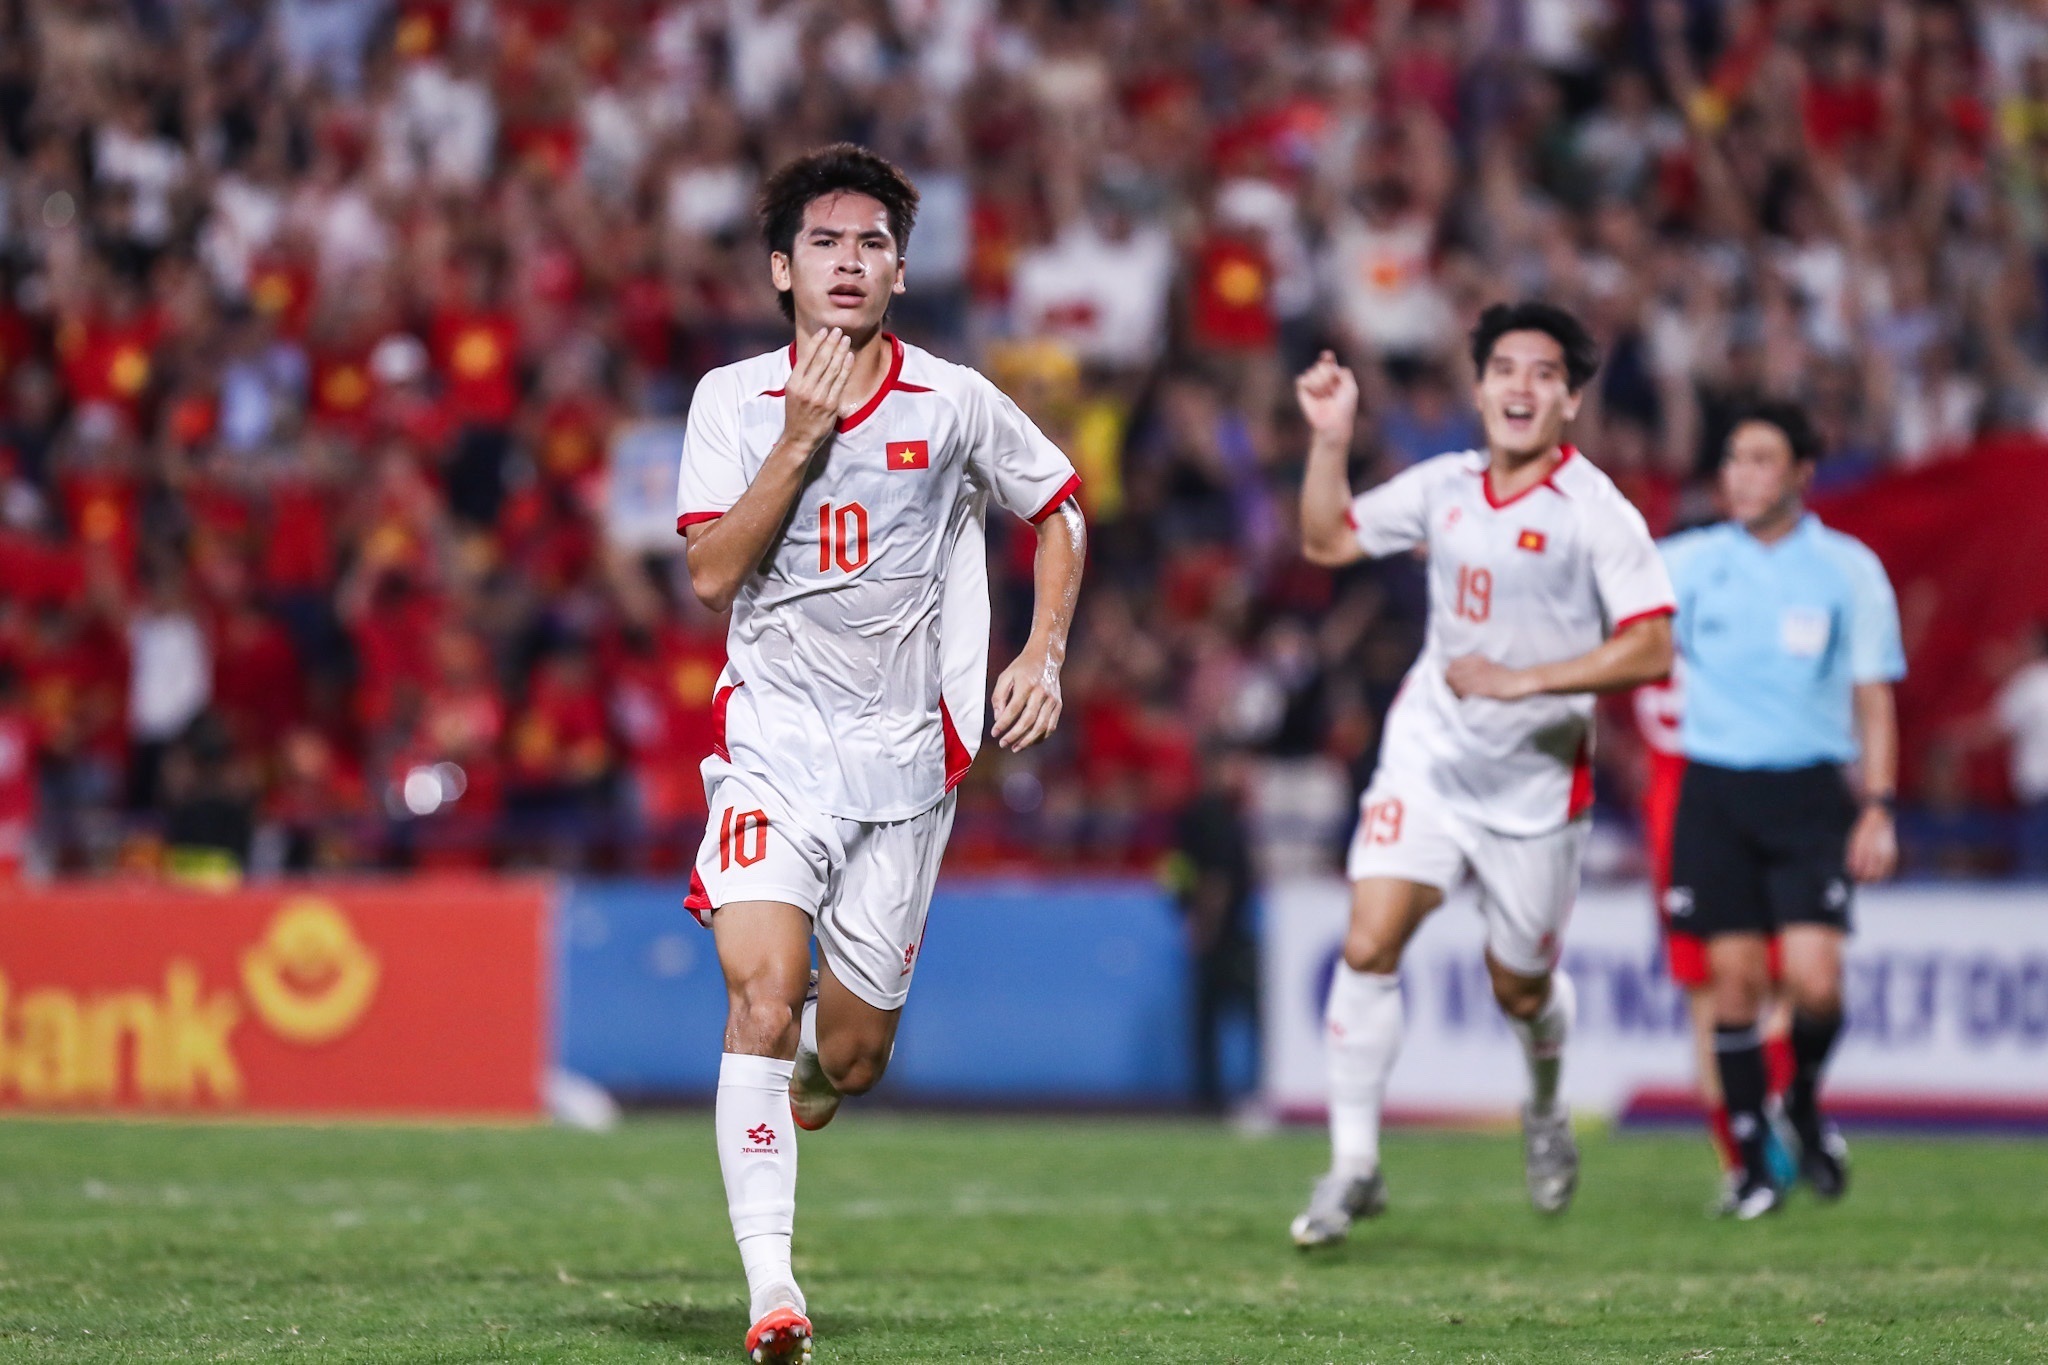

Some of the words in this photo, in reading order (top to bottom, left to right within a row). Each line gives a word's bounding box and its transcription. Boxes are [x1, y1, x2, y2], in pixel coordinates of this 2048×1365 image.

[818, 501, 869, 574] 10
[1456, 564, 1492, 624] 19
[719, 805, 769, 873] 10
[1361, 797, 1404, 848] 19
[0, 960, 240, 1098] ank
